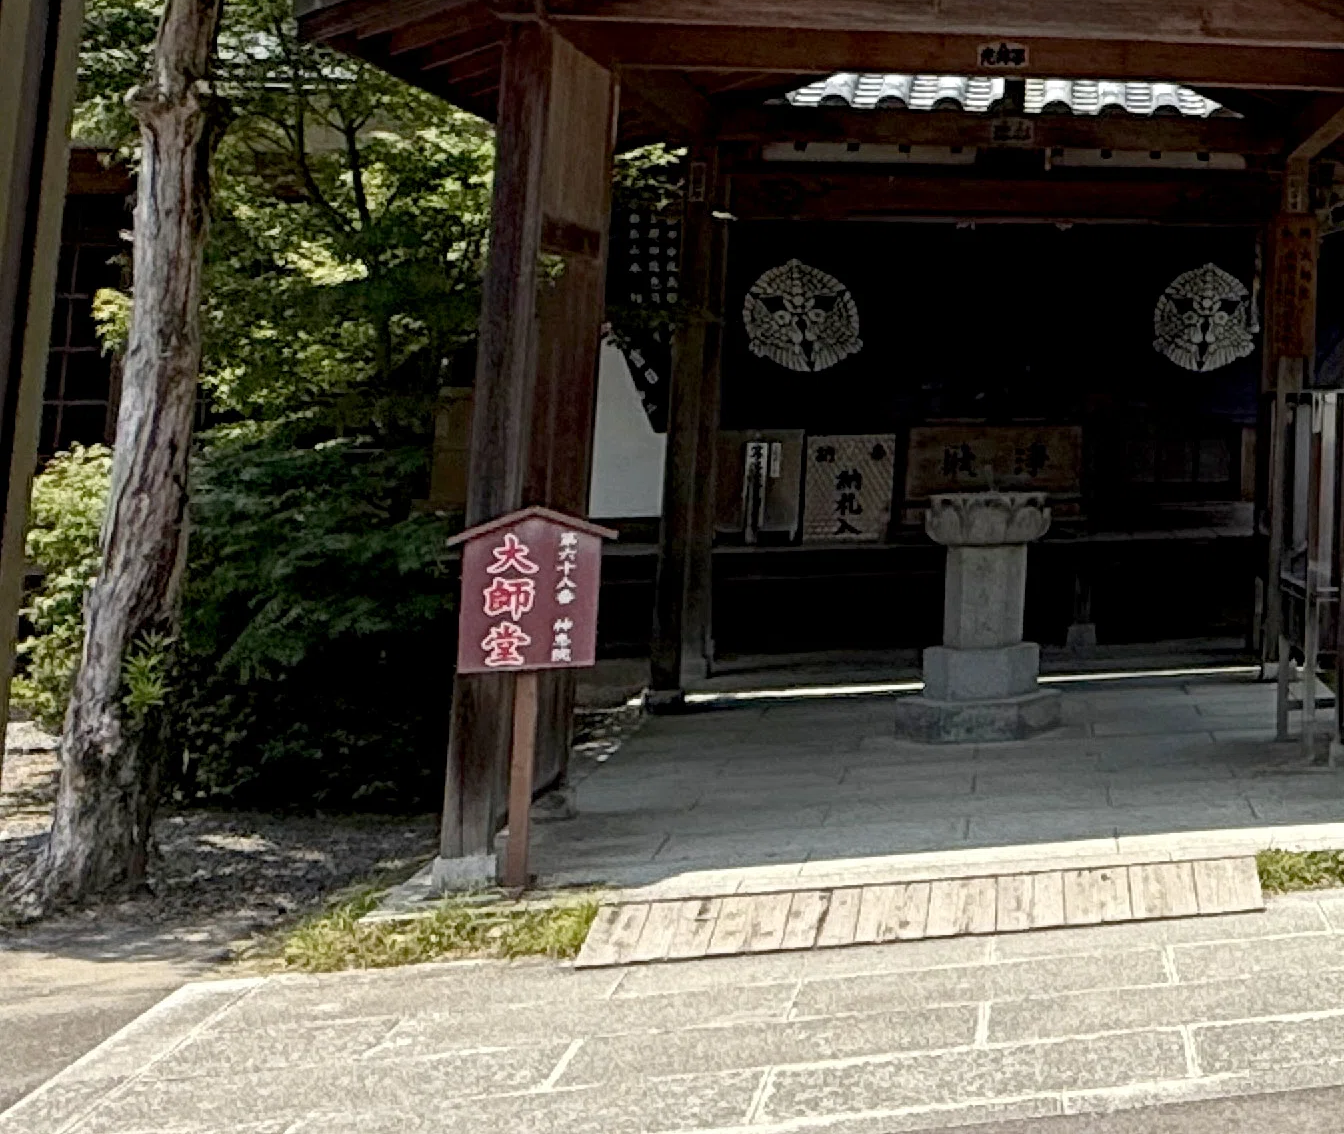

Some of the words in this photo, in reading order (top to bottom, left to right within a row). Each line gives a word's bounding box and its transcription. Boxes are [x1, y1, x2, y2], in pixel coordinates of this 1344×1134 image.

[834, 468, 864, 536] 納札入
[480, 532, 540, 668] 大師堂
[555, 532, 579, 605] 第六十八番
